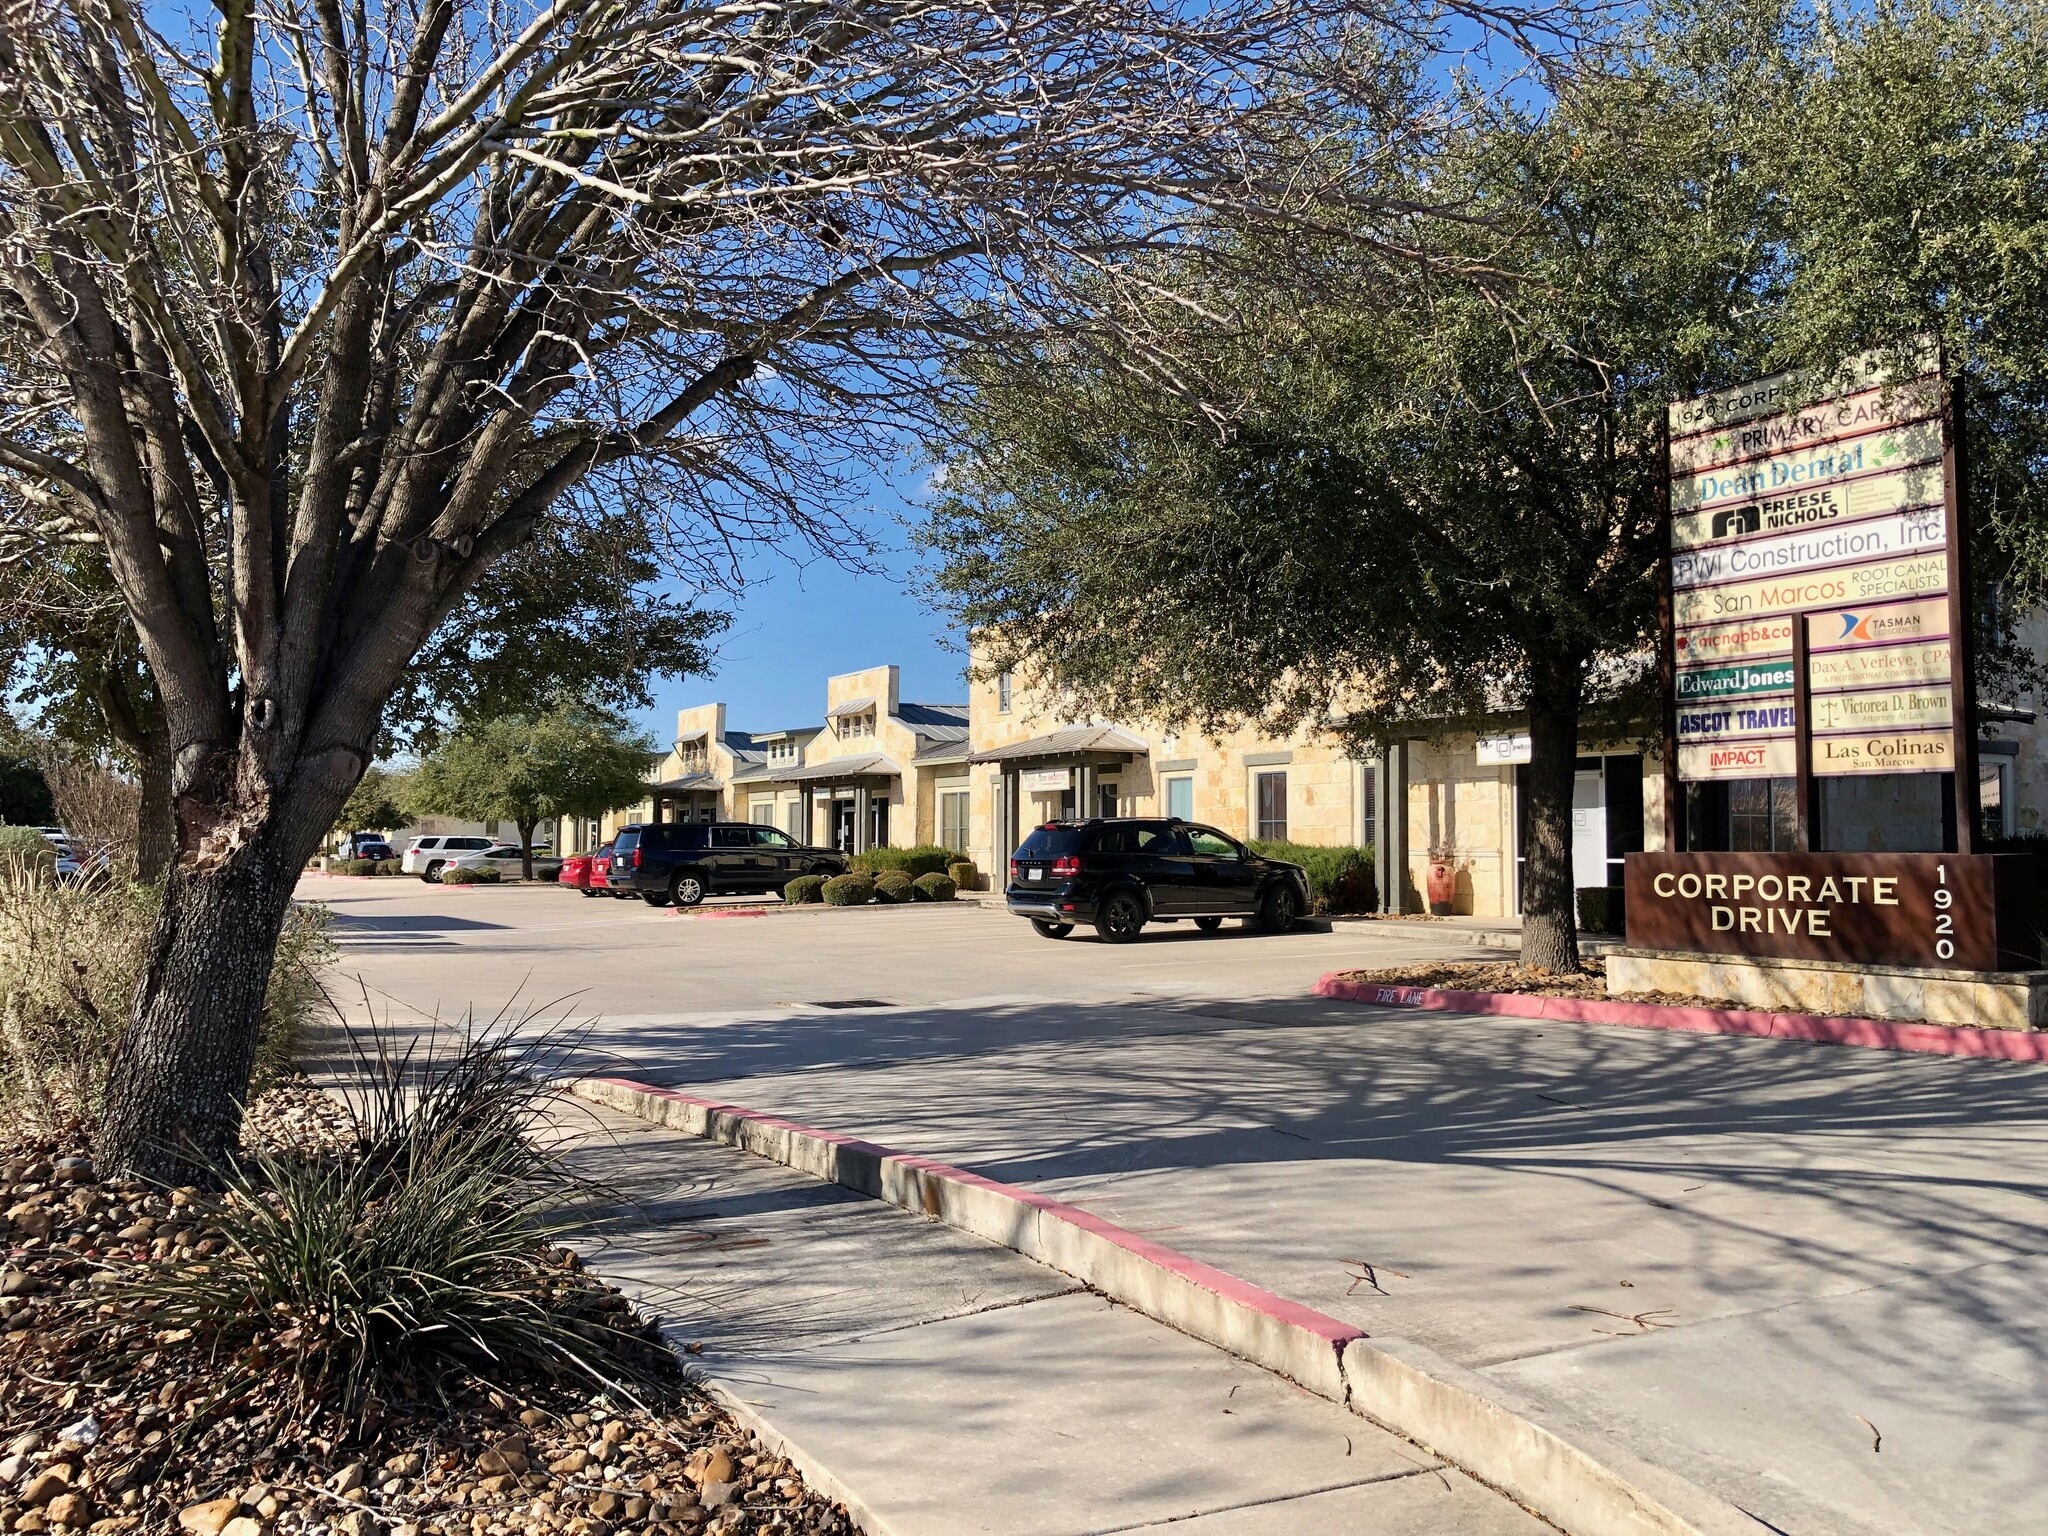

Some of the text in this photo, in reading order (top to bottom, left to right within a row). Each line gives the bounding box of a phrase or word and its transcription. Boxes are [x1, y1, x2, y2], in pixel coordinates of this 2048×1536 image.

[1742, 400, 1892, 450] PRIMARY CAR
[1701, 442, 1864, 501] Dean Dental
[1762, 490, 1832, 515] FREESE
[1767, 503, 1838, 529] NICHOLS
[1679, 522, 1947, 579] PWI Construction, Inc.
[1852, 559, 1947, 583] ROOT CANAL
[1713, 580, 1845, 614] San Marcos
[1860, 574, 1940, 597] SPECIALISTS
[1872, 615, 1921, 629] TASMAN
[1873, 625, 1921, 637] GEOSCIENCES
[1811, 649, 1952, 675] Dax A. Verleye, CPA
[1830, 670, 1883, 681] PROFESSIONAL
[1885, 666, 1942, 678] CORPORATION
[1841, 693, 1948, 715] Victorea D. Brown
[1680, 706, 1796, 734] ASCOT TRAVEL
[1862, 711, 1927, 723] Attorney At Law
[1710, 749, 1766, 767] IMPACT
[1824, 738, 1945, 759] Las Colinas
[1852, 757, 1915, 768] San Marcos
[1653, 872, 1899, 906] CORPORATE
[1711, 906, 1832, 937] DRIVE
[1376, 988, 1425, 1005] FIRE LANE
